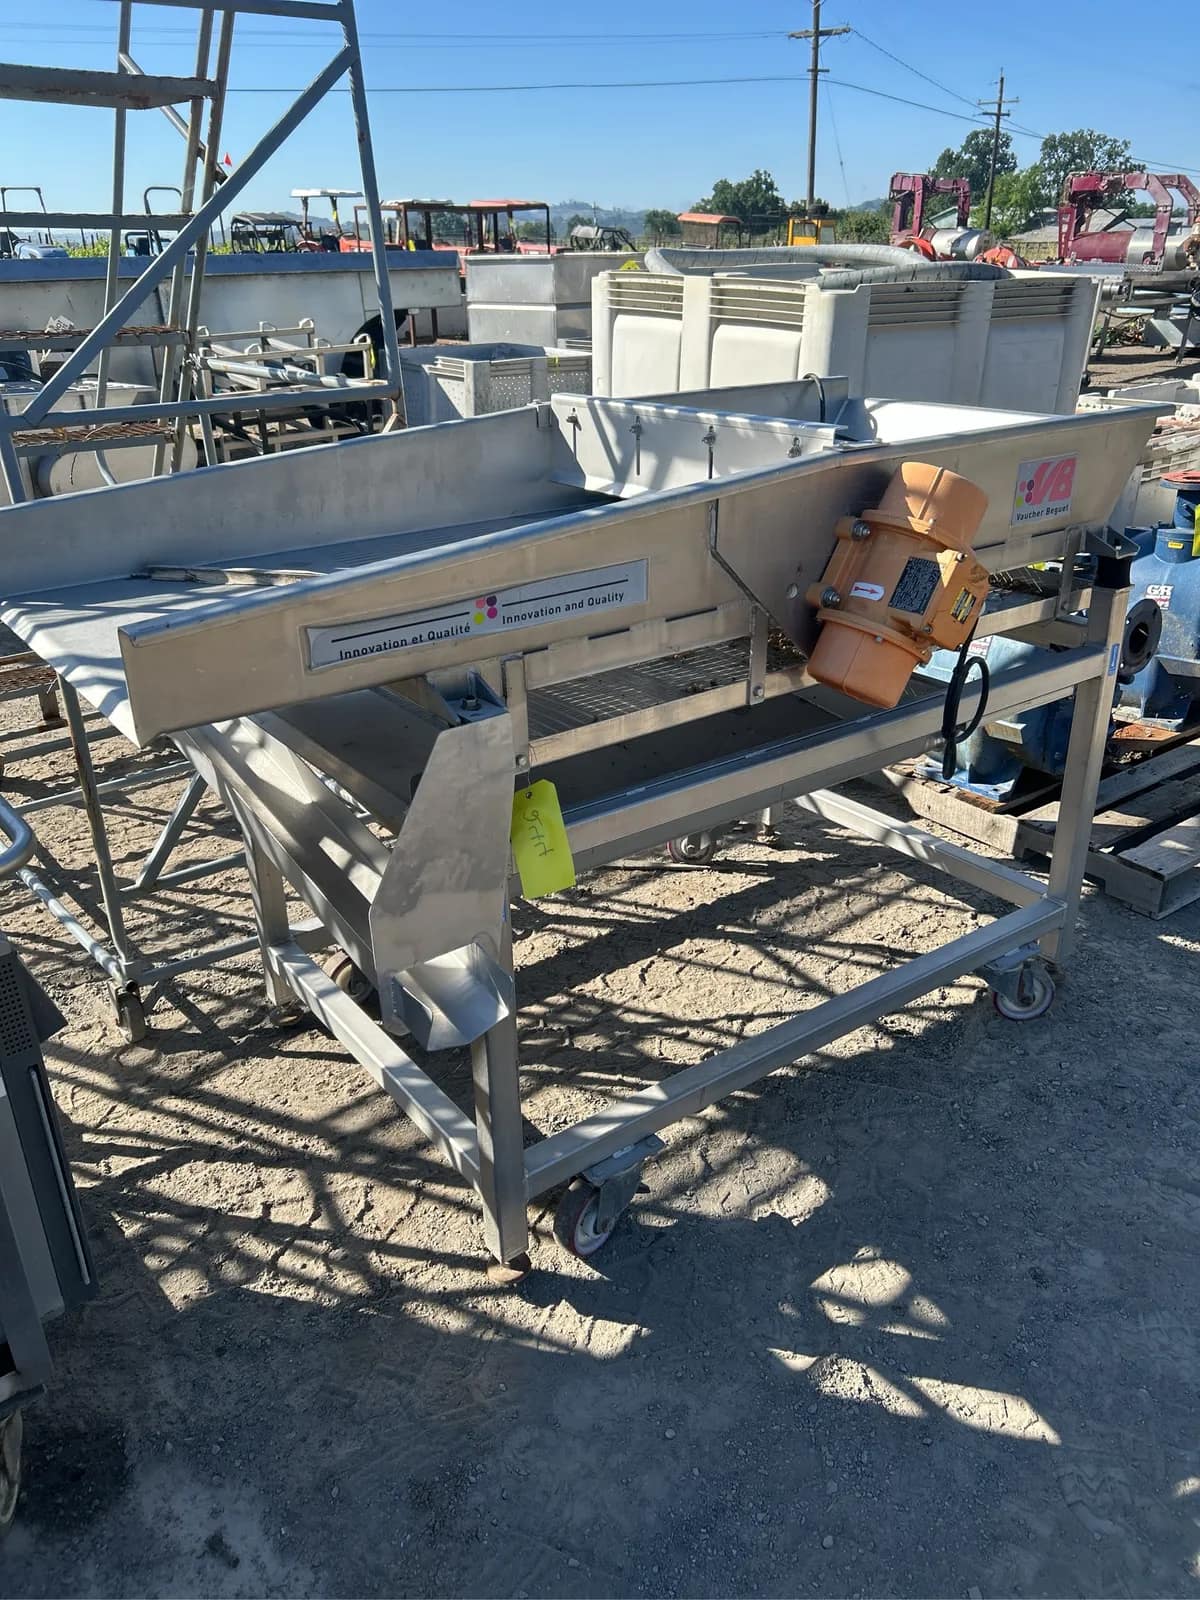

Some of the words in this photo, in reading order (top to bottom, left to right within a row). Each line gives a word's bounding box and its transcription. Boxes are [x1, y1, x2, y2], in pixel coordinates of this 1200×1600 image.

[1017, 509, 1044, 521] Vaucher
[1046, 504, 1069, 516] Beguet
[502, 605, 561, 625] Innovation
[564, 599, 584, 613] and
[587, 592, 625, 607] Quality
[339, 638, 408, 661] Innovation
[411, 633, 424, 645] et
[427, 622, 471, 642] Qualité
